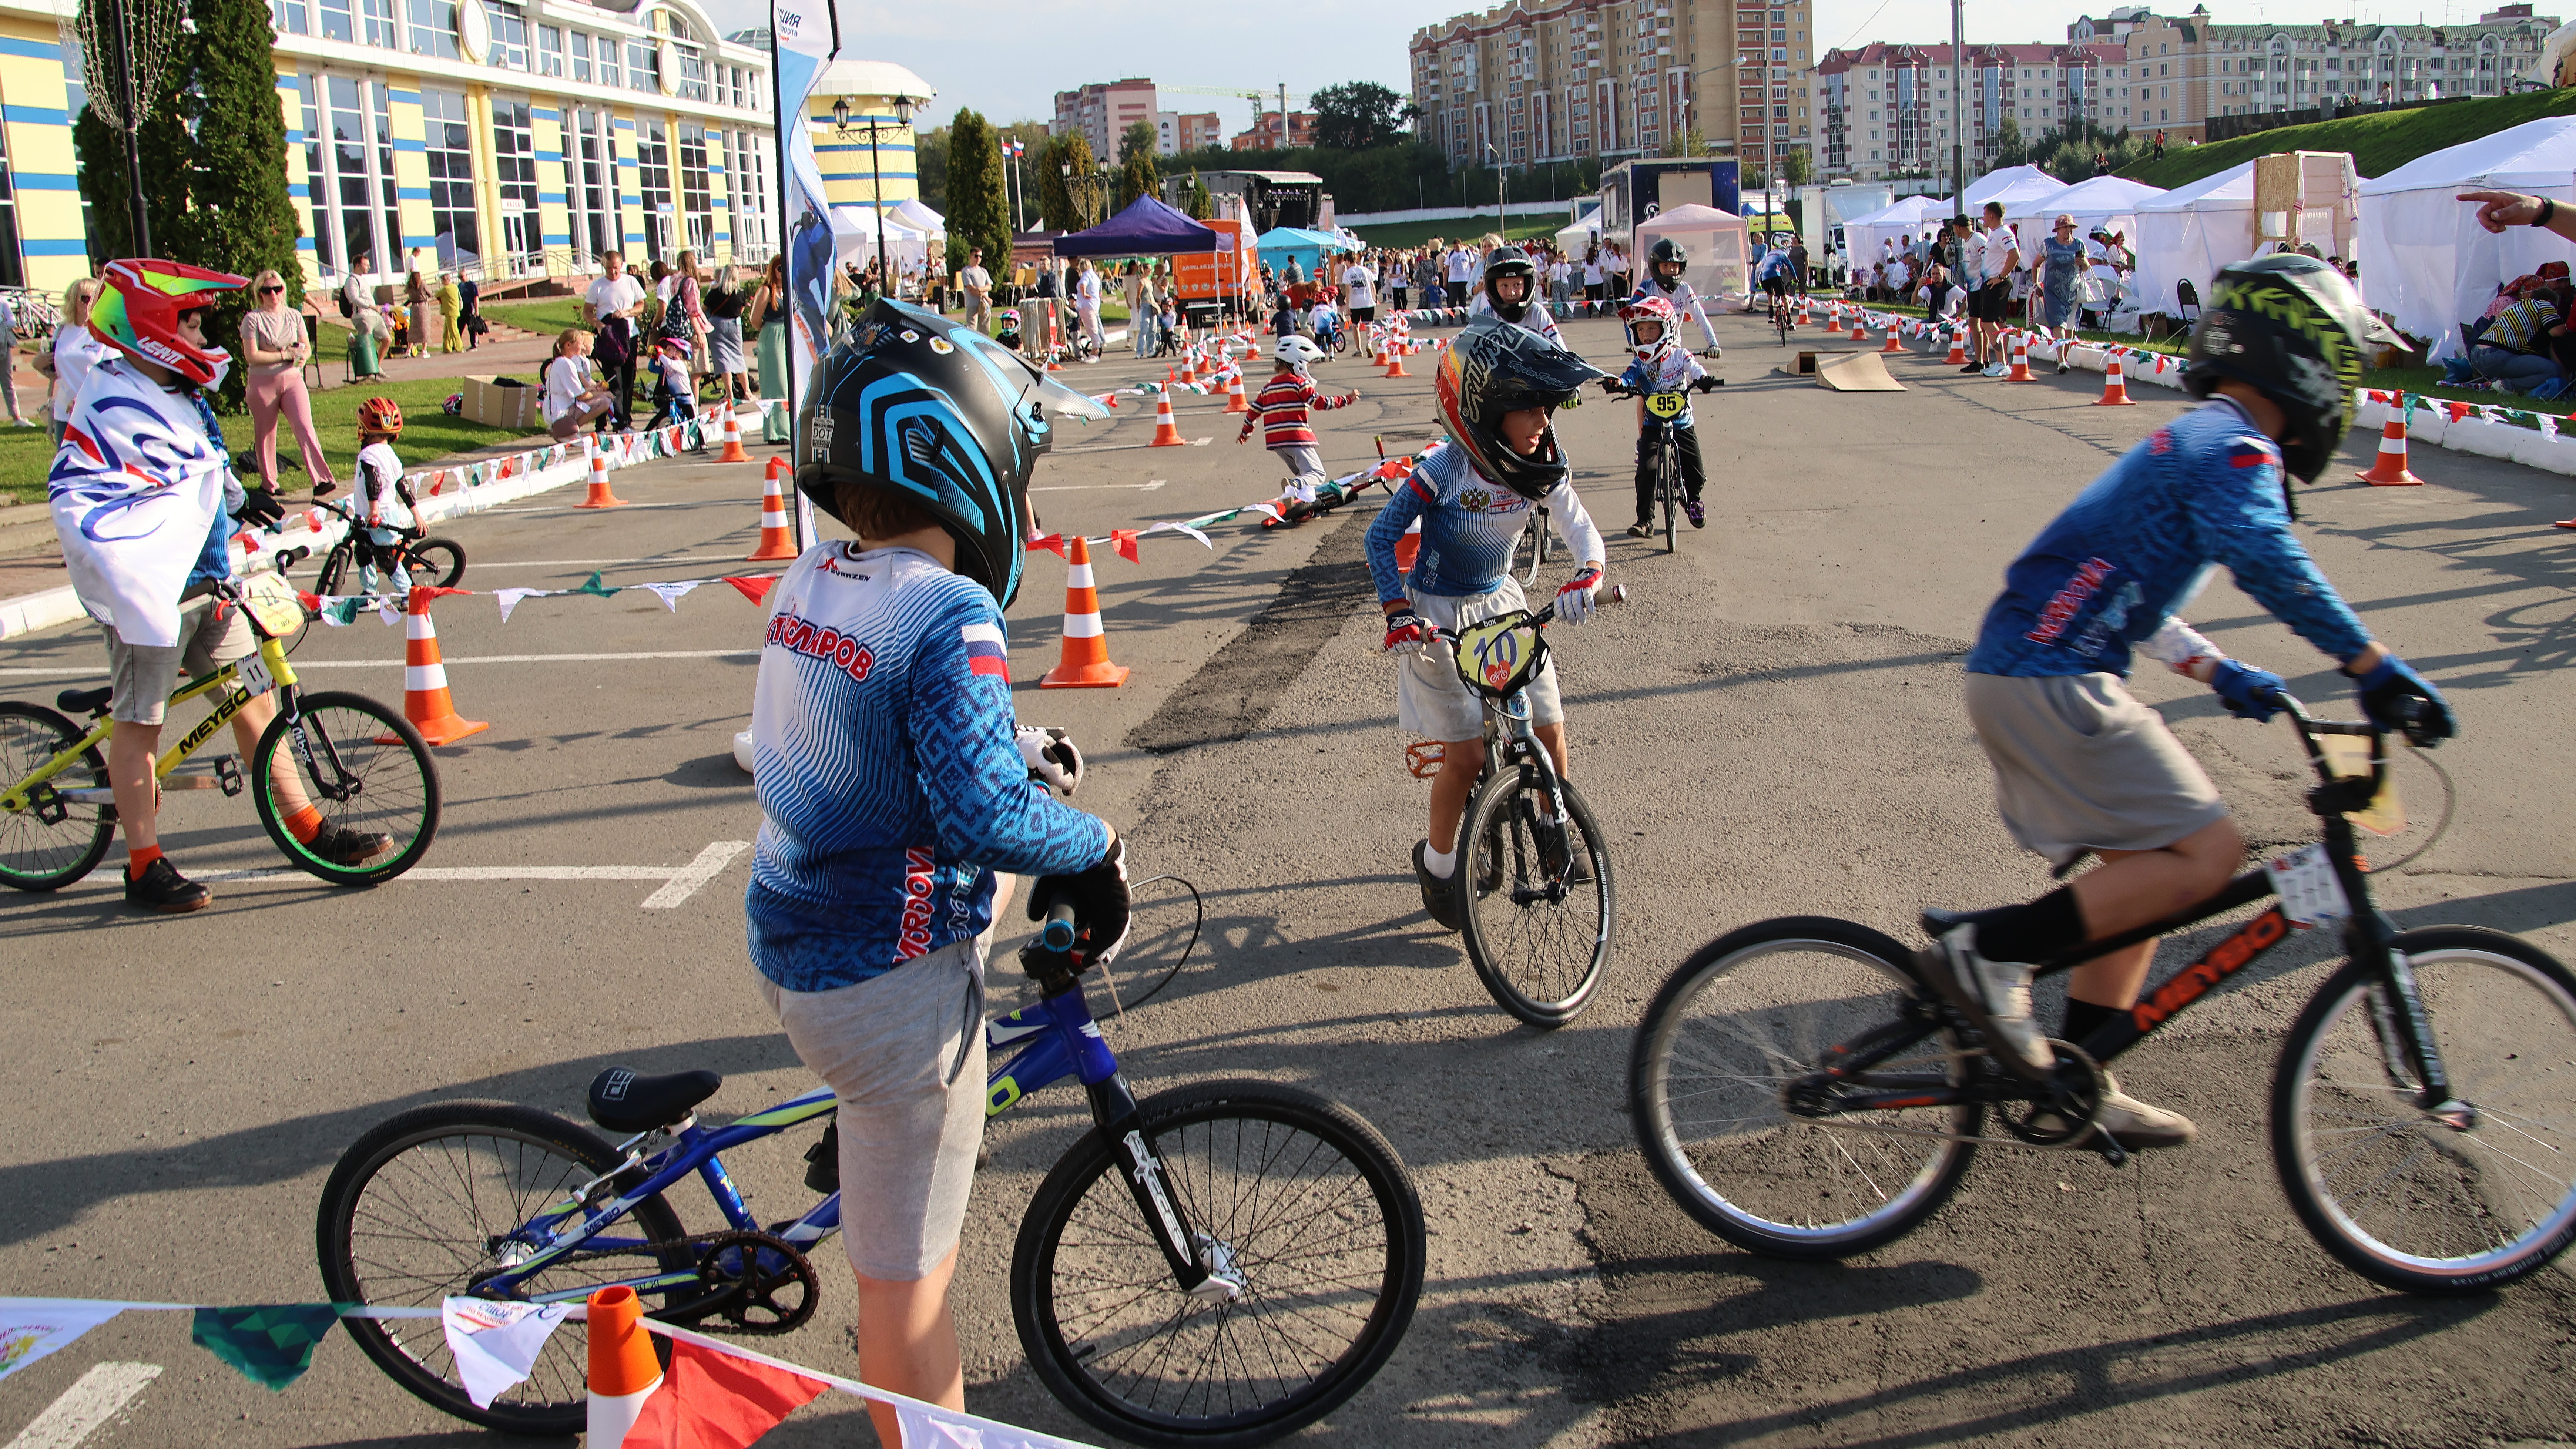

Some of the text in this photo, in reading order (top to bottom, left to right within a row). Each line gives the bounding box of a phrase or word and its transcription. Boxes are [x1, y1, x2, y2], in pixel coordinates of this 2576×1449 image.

[137, 335, 185, 365] LEATT
[1657, 397, 1676, 411] 95
[813, 428, 832, 440] DOT
[259, 586, 280, 607] 11
[1483, 618, 1496, 628] box
[1473, 630, 1519, 677] 10
[247, 663, 264, 682] 11
[179, 685, 251, 755] MEYBO
[1513, 741, 1527, 753] XE
[1552, 785, 1567, 824] box
[1595, 851, 1607, 884] COMPONENTS
